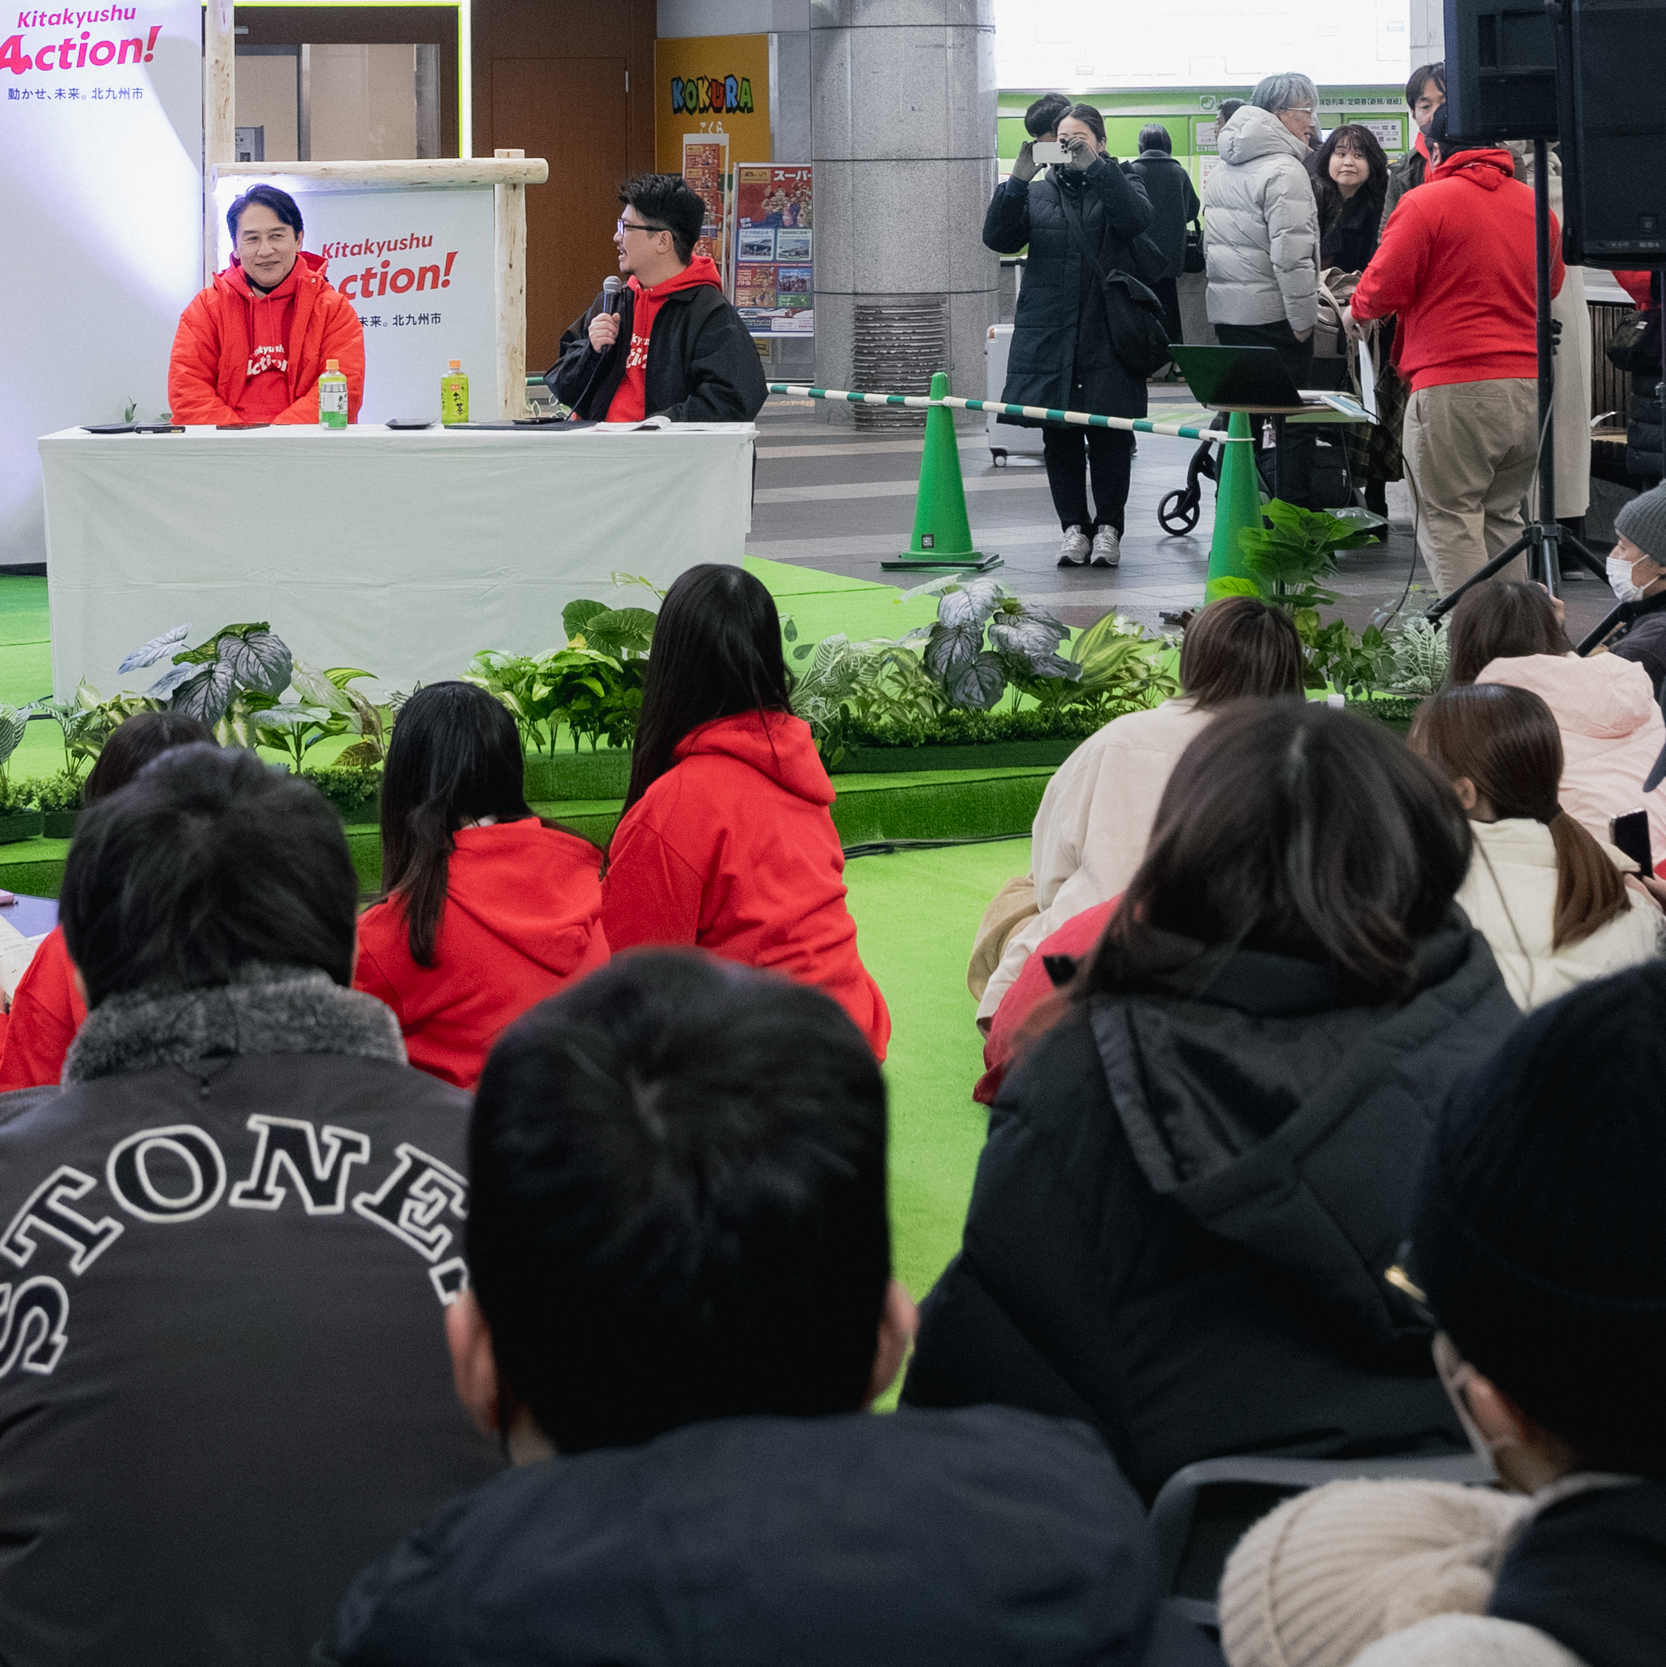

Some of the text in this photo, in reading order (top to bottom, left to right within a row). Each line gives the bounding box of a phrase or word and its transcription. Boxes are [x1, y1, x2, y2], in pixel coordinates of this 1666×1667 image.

[17, 4, 137, 28] Kitakyushu
[7, 87, 144, 101] 動かせ、未来。北九州市
[671, 74, 754, 116] KOKURA
[774, 170, 812, 181] スーパ
[321, 232, 434, 260] Kitakyushu
[333, 251, 460, 301] ction!
